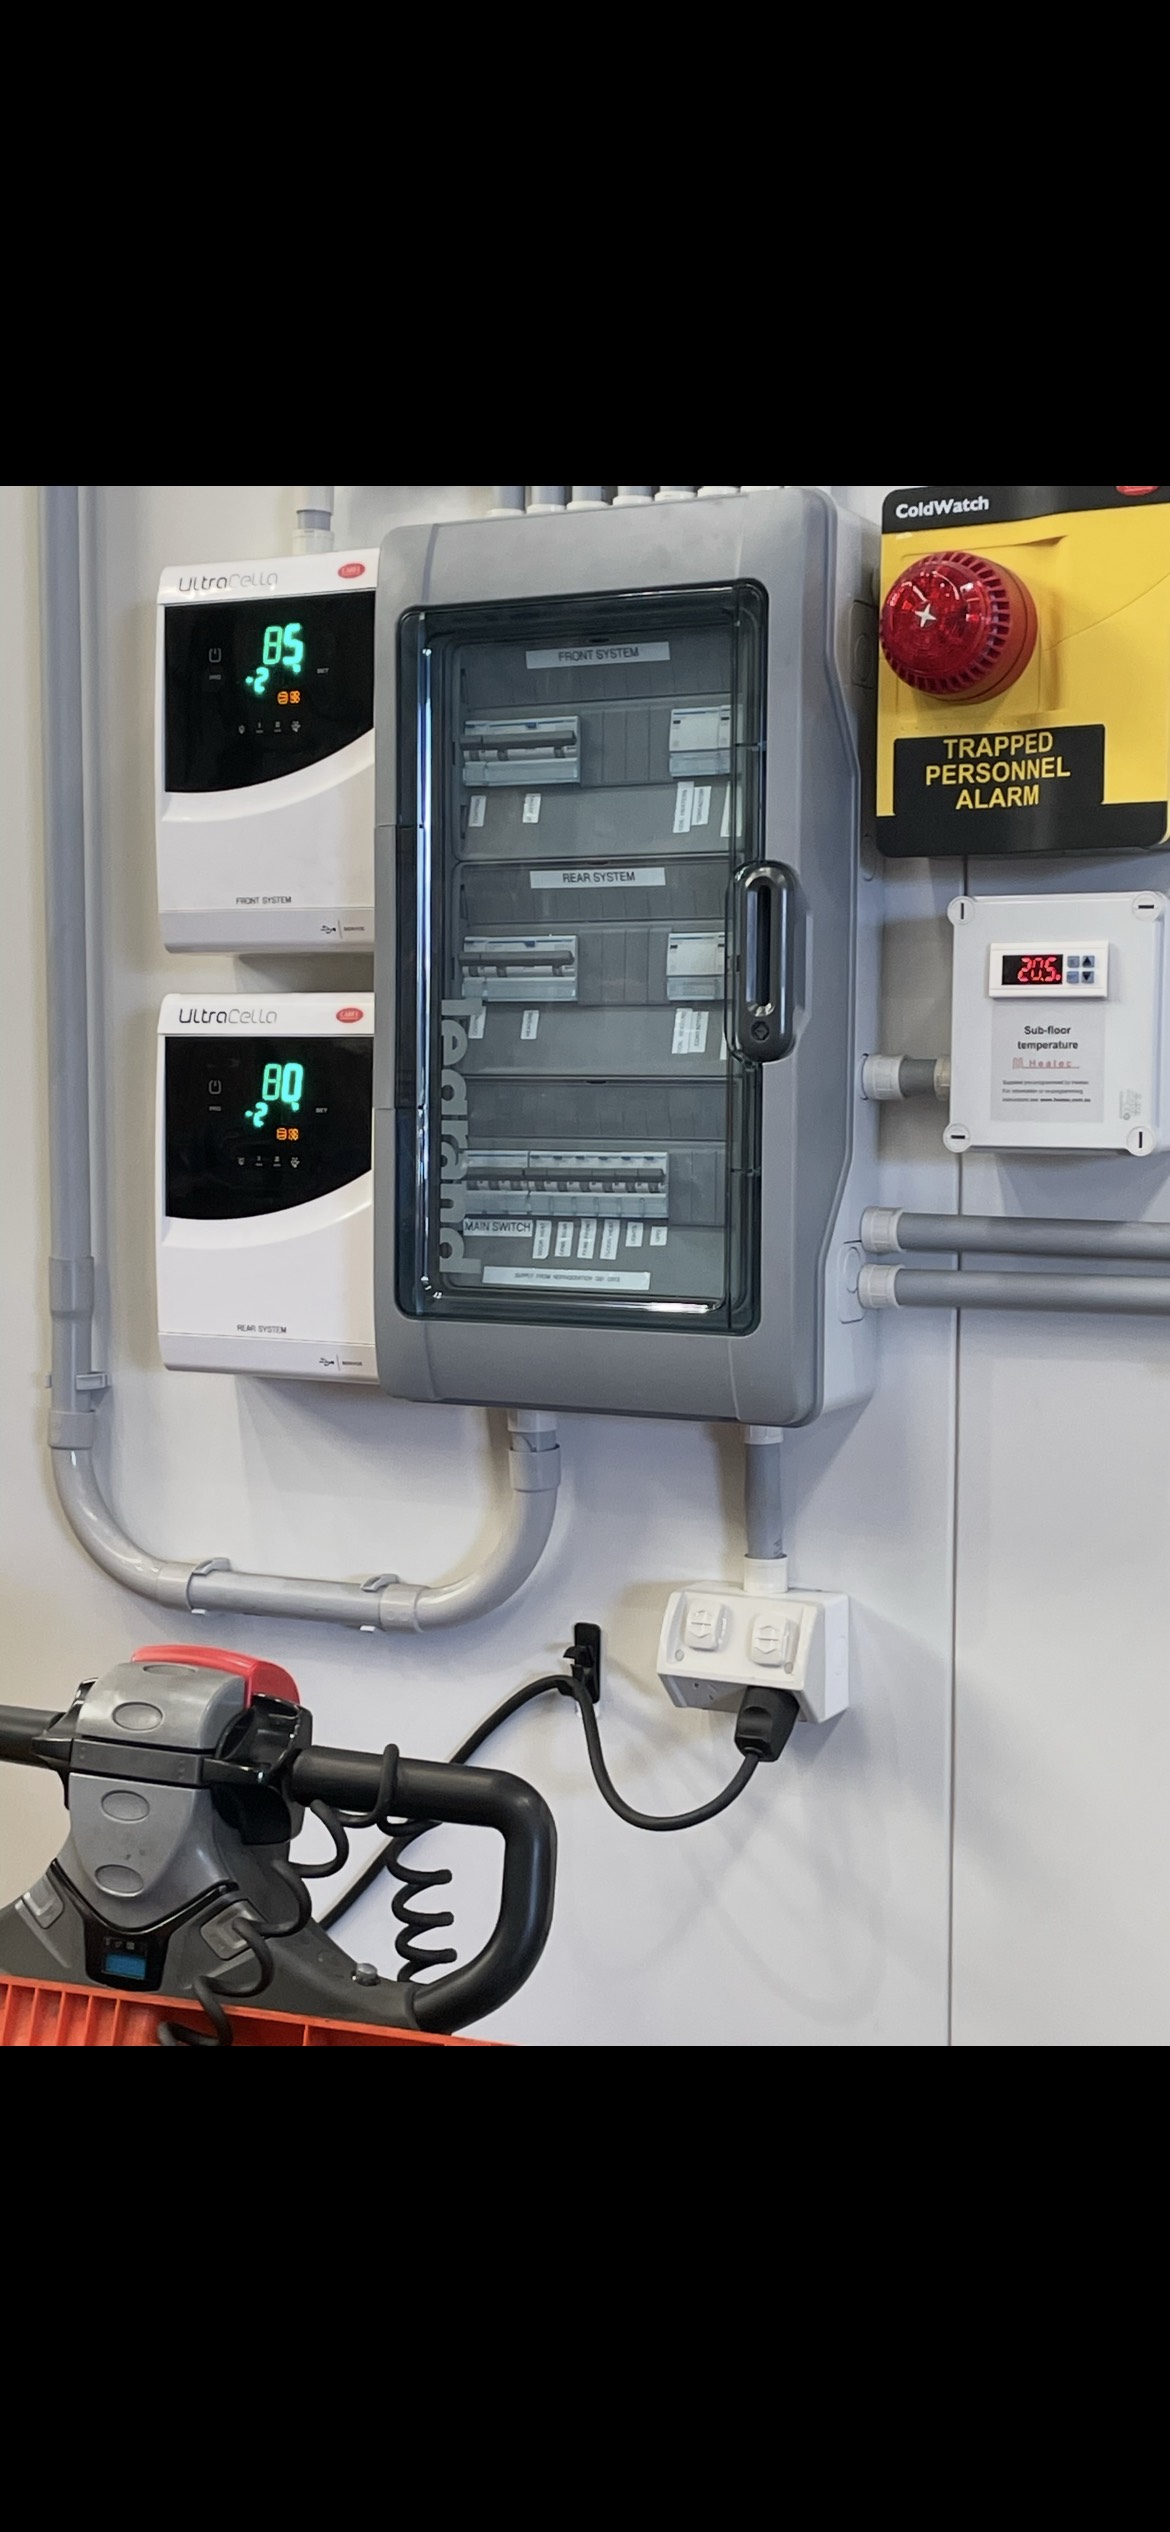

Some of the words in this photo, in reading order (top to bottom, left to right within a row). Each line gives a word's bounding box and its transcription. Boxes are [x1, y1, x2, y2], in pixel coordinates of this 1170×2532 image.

[895, 496, 990, 518] ColdWatch
[178, 572, 278, 592] UltraCella
[558, 650, 594, 661] FRONT
[595, 647, 639, 660] SYSTEM
[943, 731, 1054, 759] TRAPPED
[925, 756, 1071, 786] PERSONNEL
[955, 784, 1039, 810] ALARM
[562, 873, 591, 883] REAR
[592, 871, 636, 883] SYSTEM
[236, 896, 260, 905] FRONT
[262, 896, 292, 904] SYSTEM
[178, 1008, 278, 1024] UltraCella
[1023, 1025, 1072, 1035] Sub-floor
[1017, 1041, 1079, 1051] temperature
[464, 1220, 490, 1233] MAIN
[491, 1221, 531, 1234] SWITCH
[237, 1324, 256, 1333] REAR
[258, 1325, 287, 1334] SYSTEM
